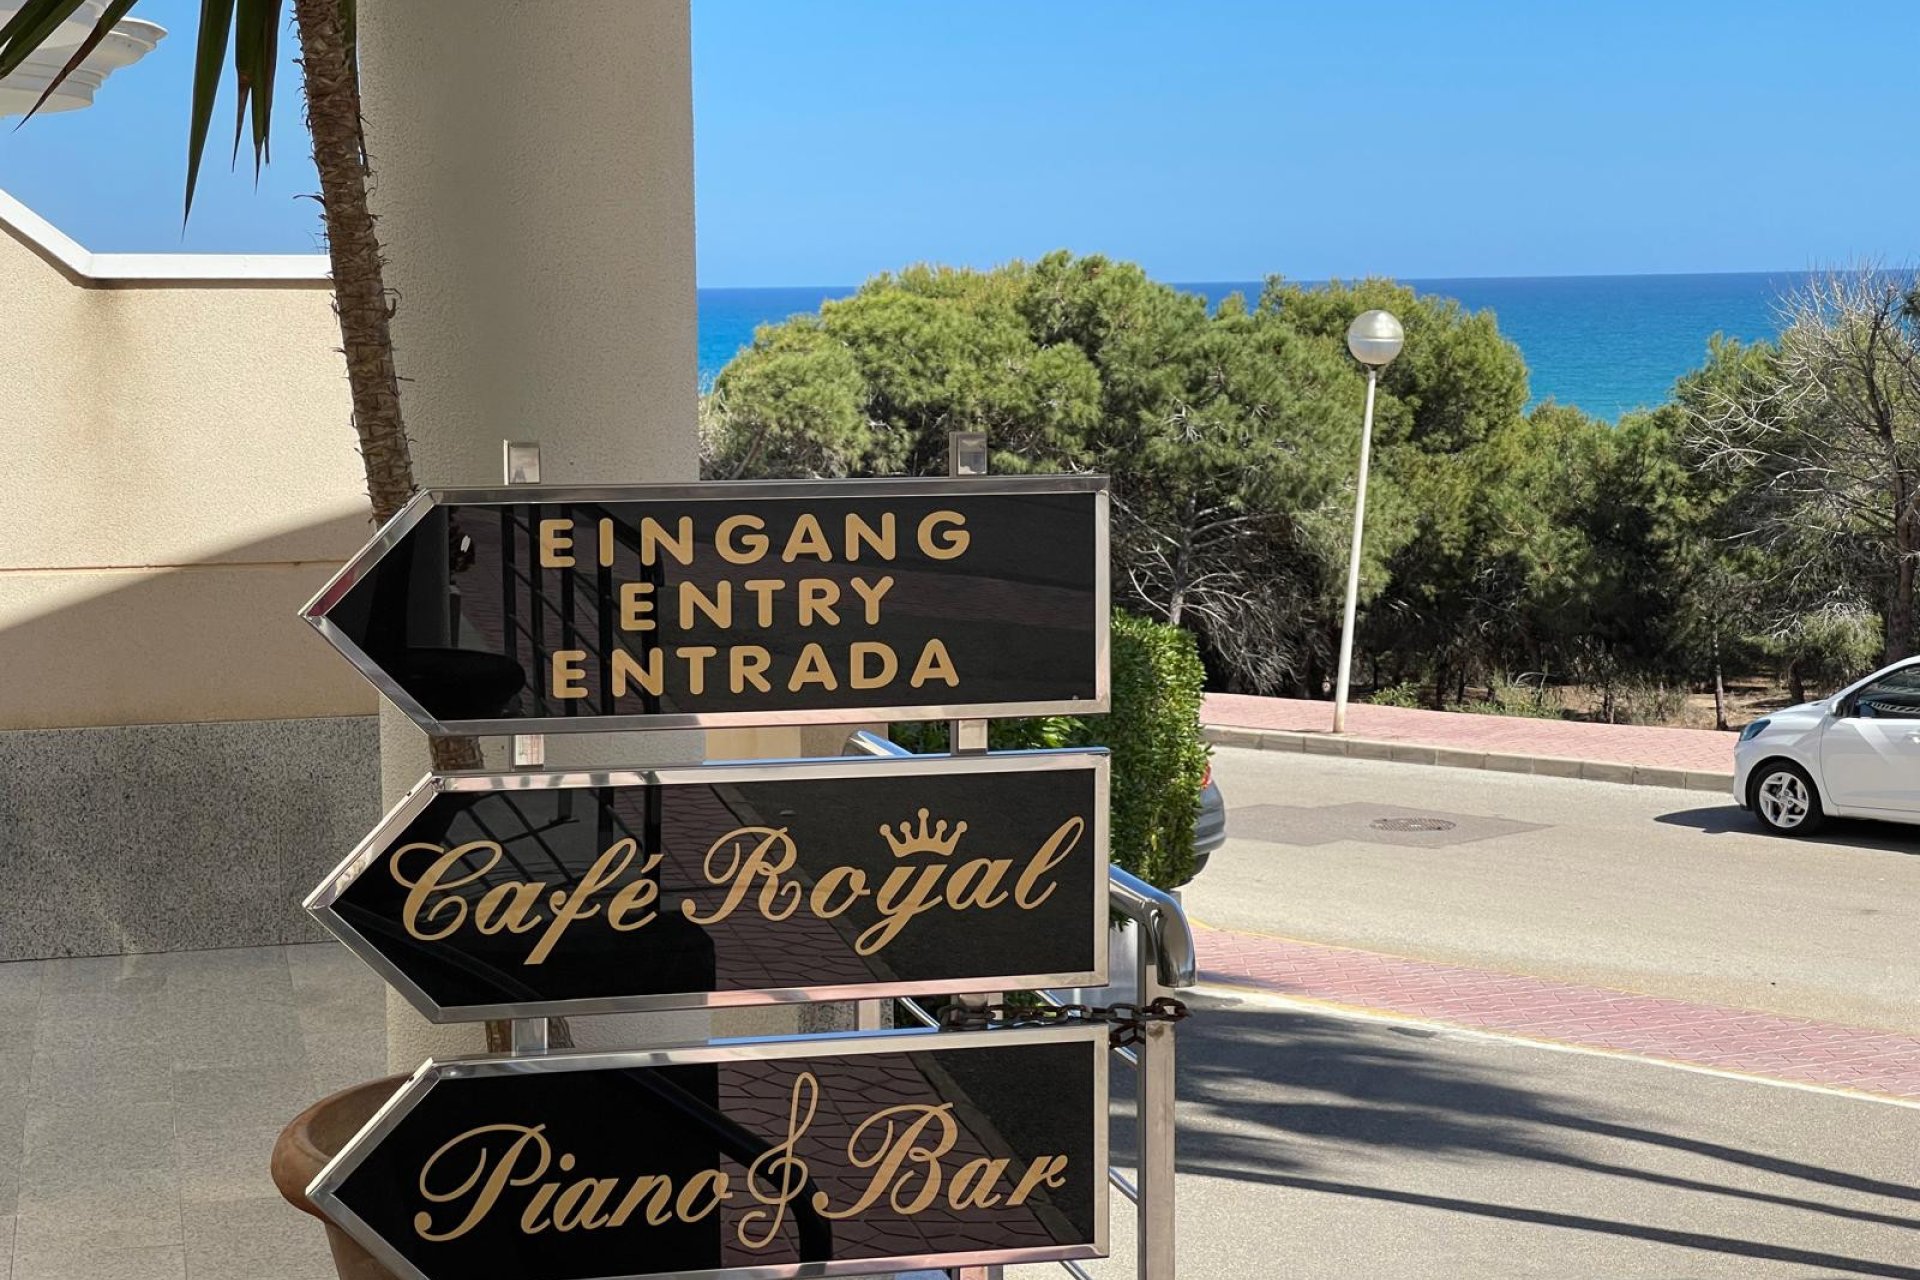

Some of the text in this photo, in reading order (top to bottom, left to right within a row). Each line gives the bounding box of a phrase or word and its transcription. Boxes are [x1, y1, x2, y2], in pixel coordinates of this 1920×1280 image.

[539, 510, 971, 569] EINGANG
[620, 575, 895, 632] ENTRY
[552, 638, 960, 700] ENTRADA
[389, 815, 1085, 965] Café Royal
[414, 1103, 1067, 1242] Piano Bar
